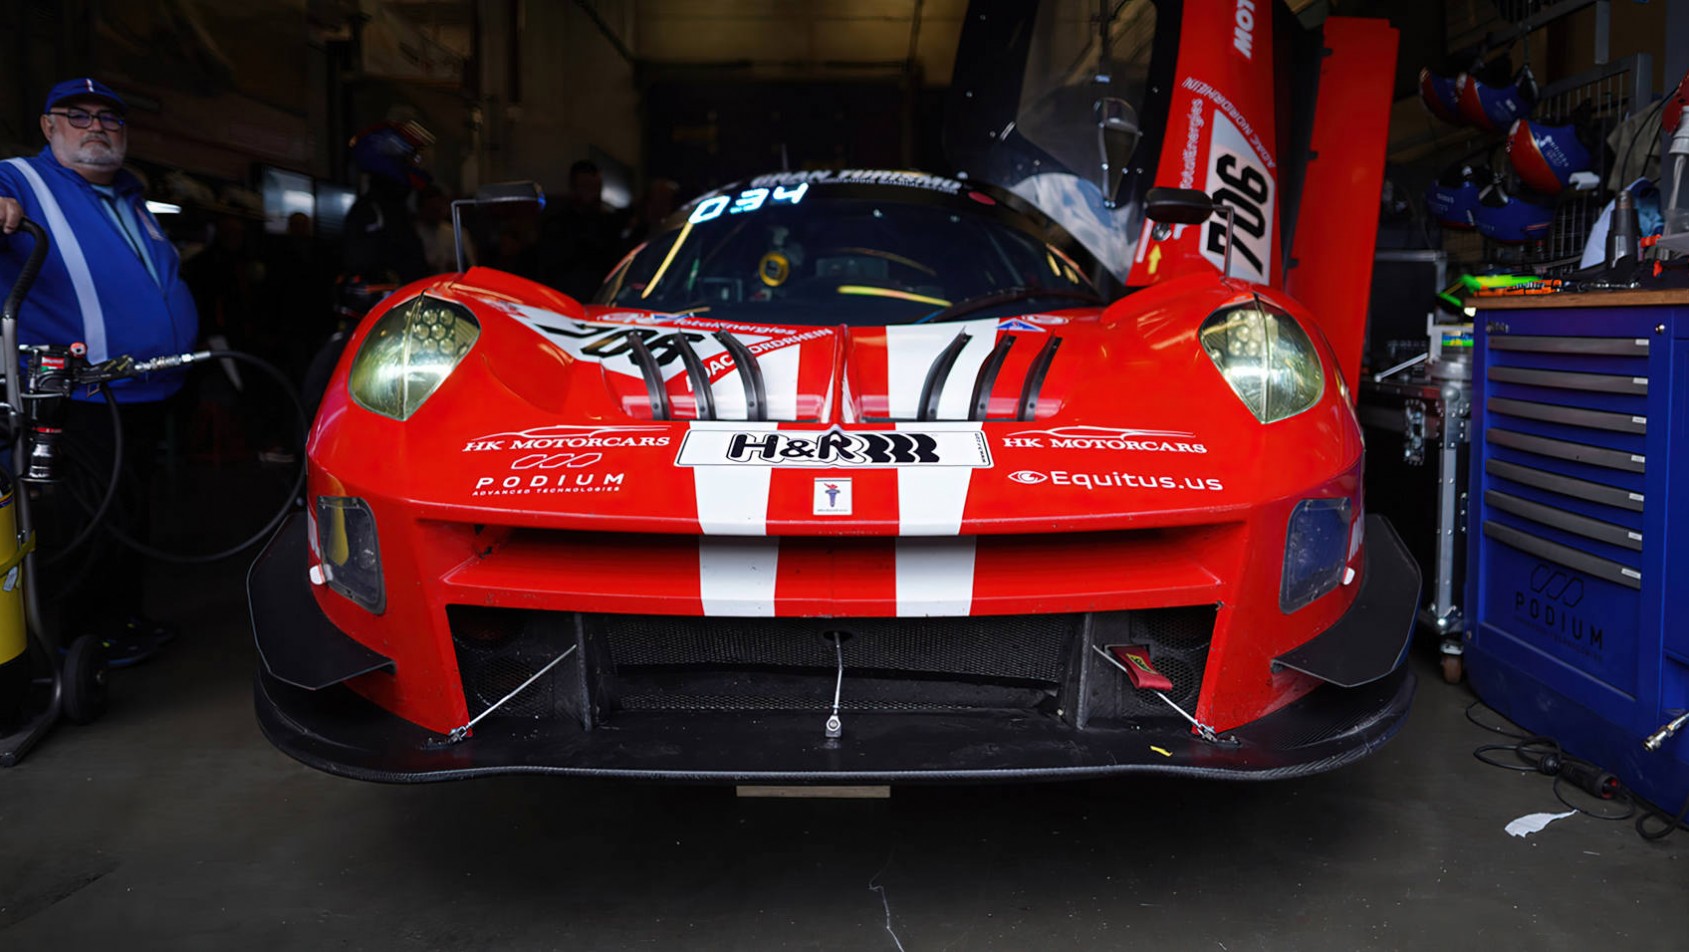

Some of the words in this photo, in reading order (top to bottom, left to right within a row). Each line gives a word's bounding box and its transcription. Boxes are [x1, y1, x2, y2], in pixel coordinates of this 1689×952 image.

[1206, 153, 1269, 277] 706
[749, 328, 834, 355] ORDRHEIN
[462, 440, 505, 452] HK
[510, 436, 671, 451] MOTORCARS
[1002, 437, 1045, 449] HK
[1050, 438, 1208, 454] MOTORCARS
[475, 473, 625, 489] PODIUM
[1050, 471, 1224, 491] Equitus.us
[472, 487, 531, 496] ADVANCED
[536, 486, 620, 494] TECHNOLOGIES
[1514, 591, 1604, 652] PODIUM
